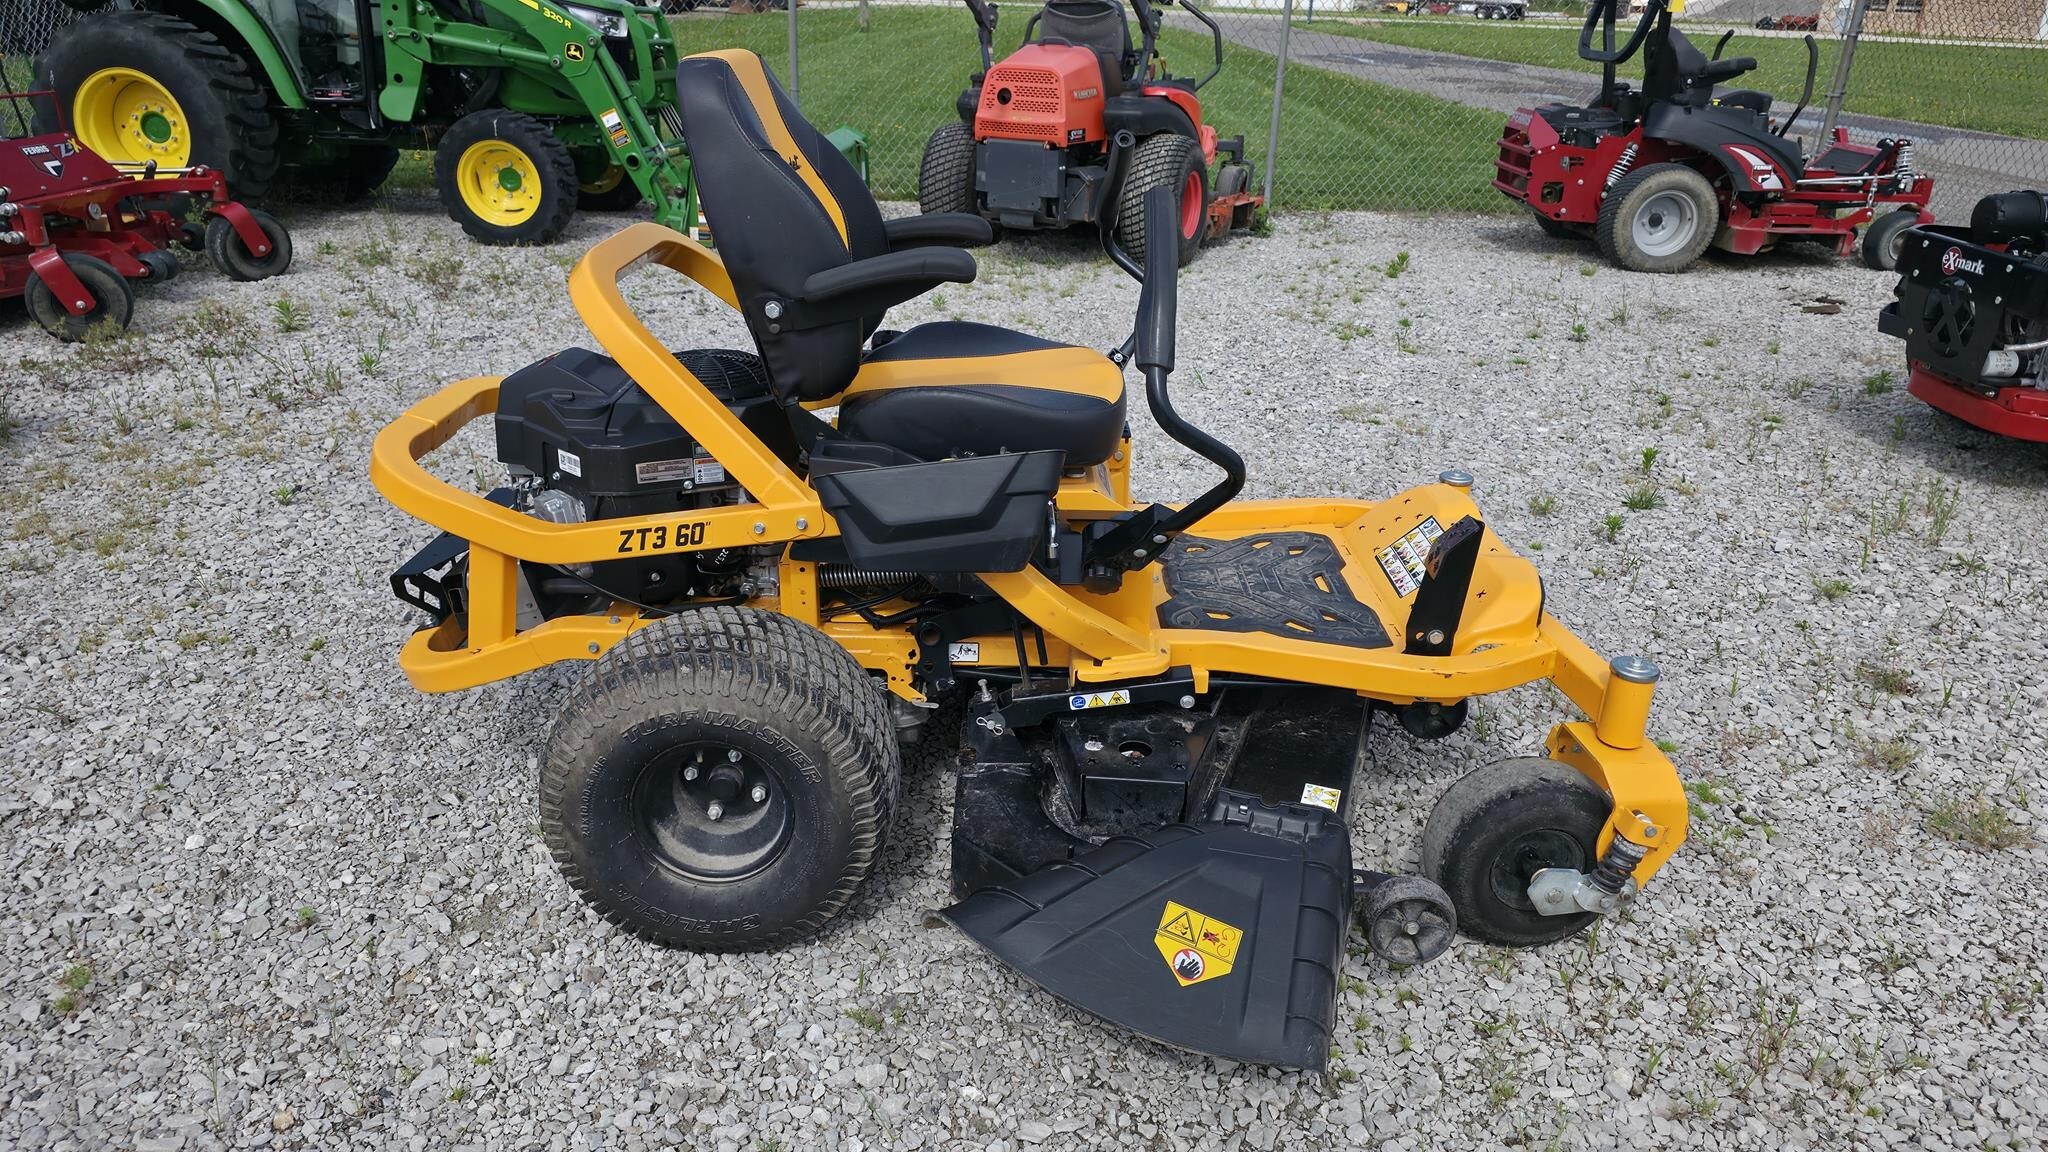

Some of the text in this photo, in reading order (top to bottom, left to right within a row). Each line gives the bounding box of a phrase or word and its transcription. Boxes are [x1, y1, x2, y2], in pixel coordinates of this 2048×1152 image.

[543, 7, 572, 29] 320 R
[618, 526, 667, 553] ZT3
[620, 710, 822, 785] TURF MASTER
